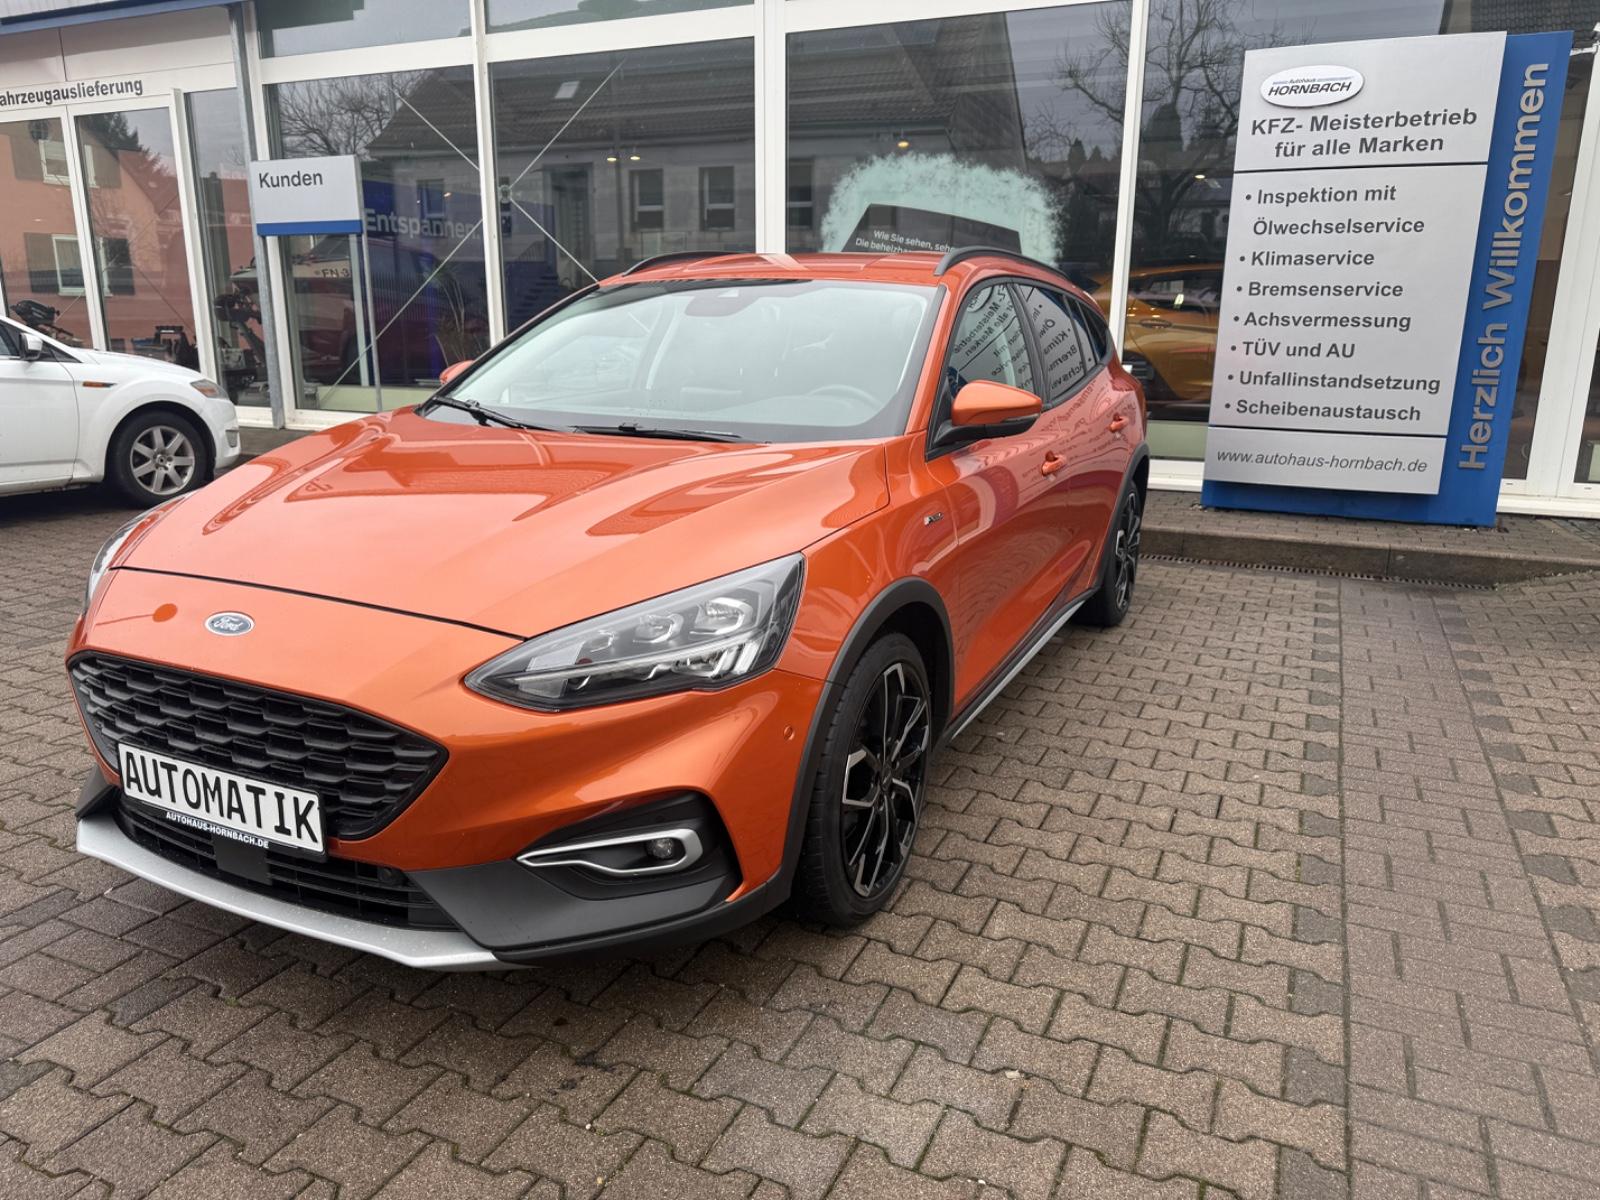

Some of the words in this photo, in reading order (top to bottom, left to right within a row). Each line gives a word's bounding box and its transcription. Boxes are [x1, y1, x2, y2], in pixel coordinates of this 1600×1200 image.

[1267, 80, 1352, 97] HORNBACH
[1251, 117, 1303, 136] KFZ-
[1310, 108, 1478, 132] Meisterbetrieb
[1274, 141, 1306, 158] für
[1311, 139, 1351, 156] alle
[1358, 136, 1444, 154] Marken
[258, 170, 324, 189] Kunden
[1482, 63, 1549, 310] Willkommen
[1257, 187, 1358, 207] Inspektion
[1364, 185, 1397, 201] mit
[1253, 217, 1425, 235] Ölwechselservice
[1251, 250, 1375, 266] Klimaservice
[1248, 281, 1403, 297] Bremsenservice
[1243, 312, 1412, 332] Achsvermessung
[1243, 337, 1281, 356] TÜV
[1285, 343, 1322, 357] und
[1325, 343, 1355, 358] AU
[1239, 370, 1441, 394] Unfallinstandsetzung
[1457, 322, 1508, 470] Herzlich
[1236, 399, 1421, 421] Scheibenaustausch
[1216, 450, 1428, 473] www.autohaus-hornbach.de
[125, 751, 319, 844] AUTOMATIK
[165, 811, 270, 850] AUTOHAUS-HORNBACH.DE
